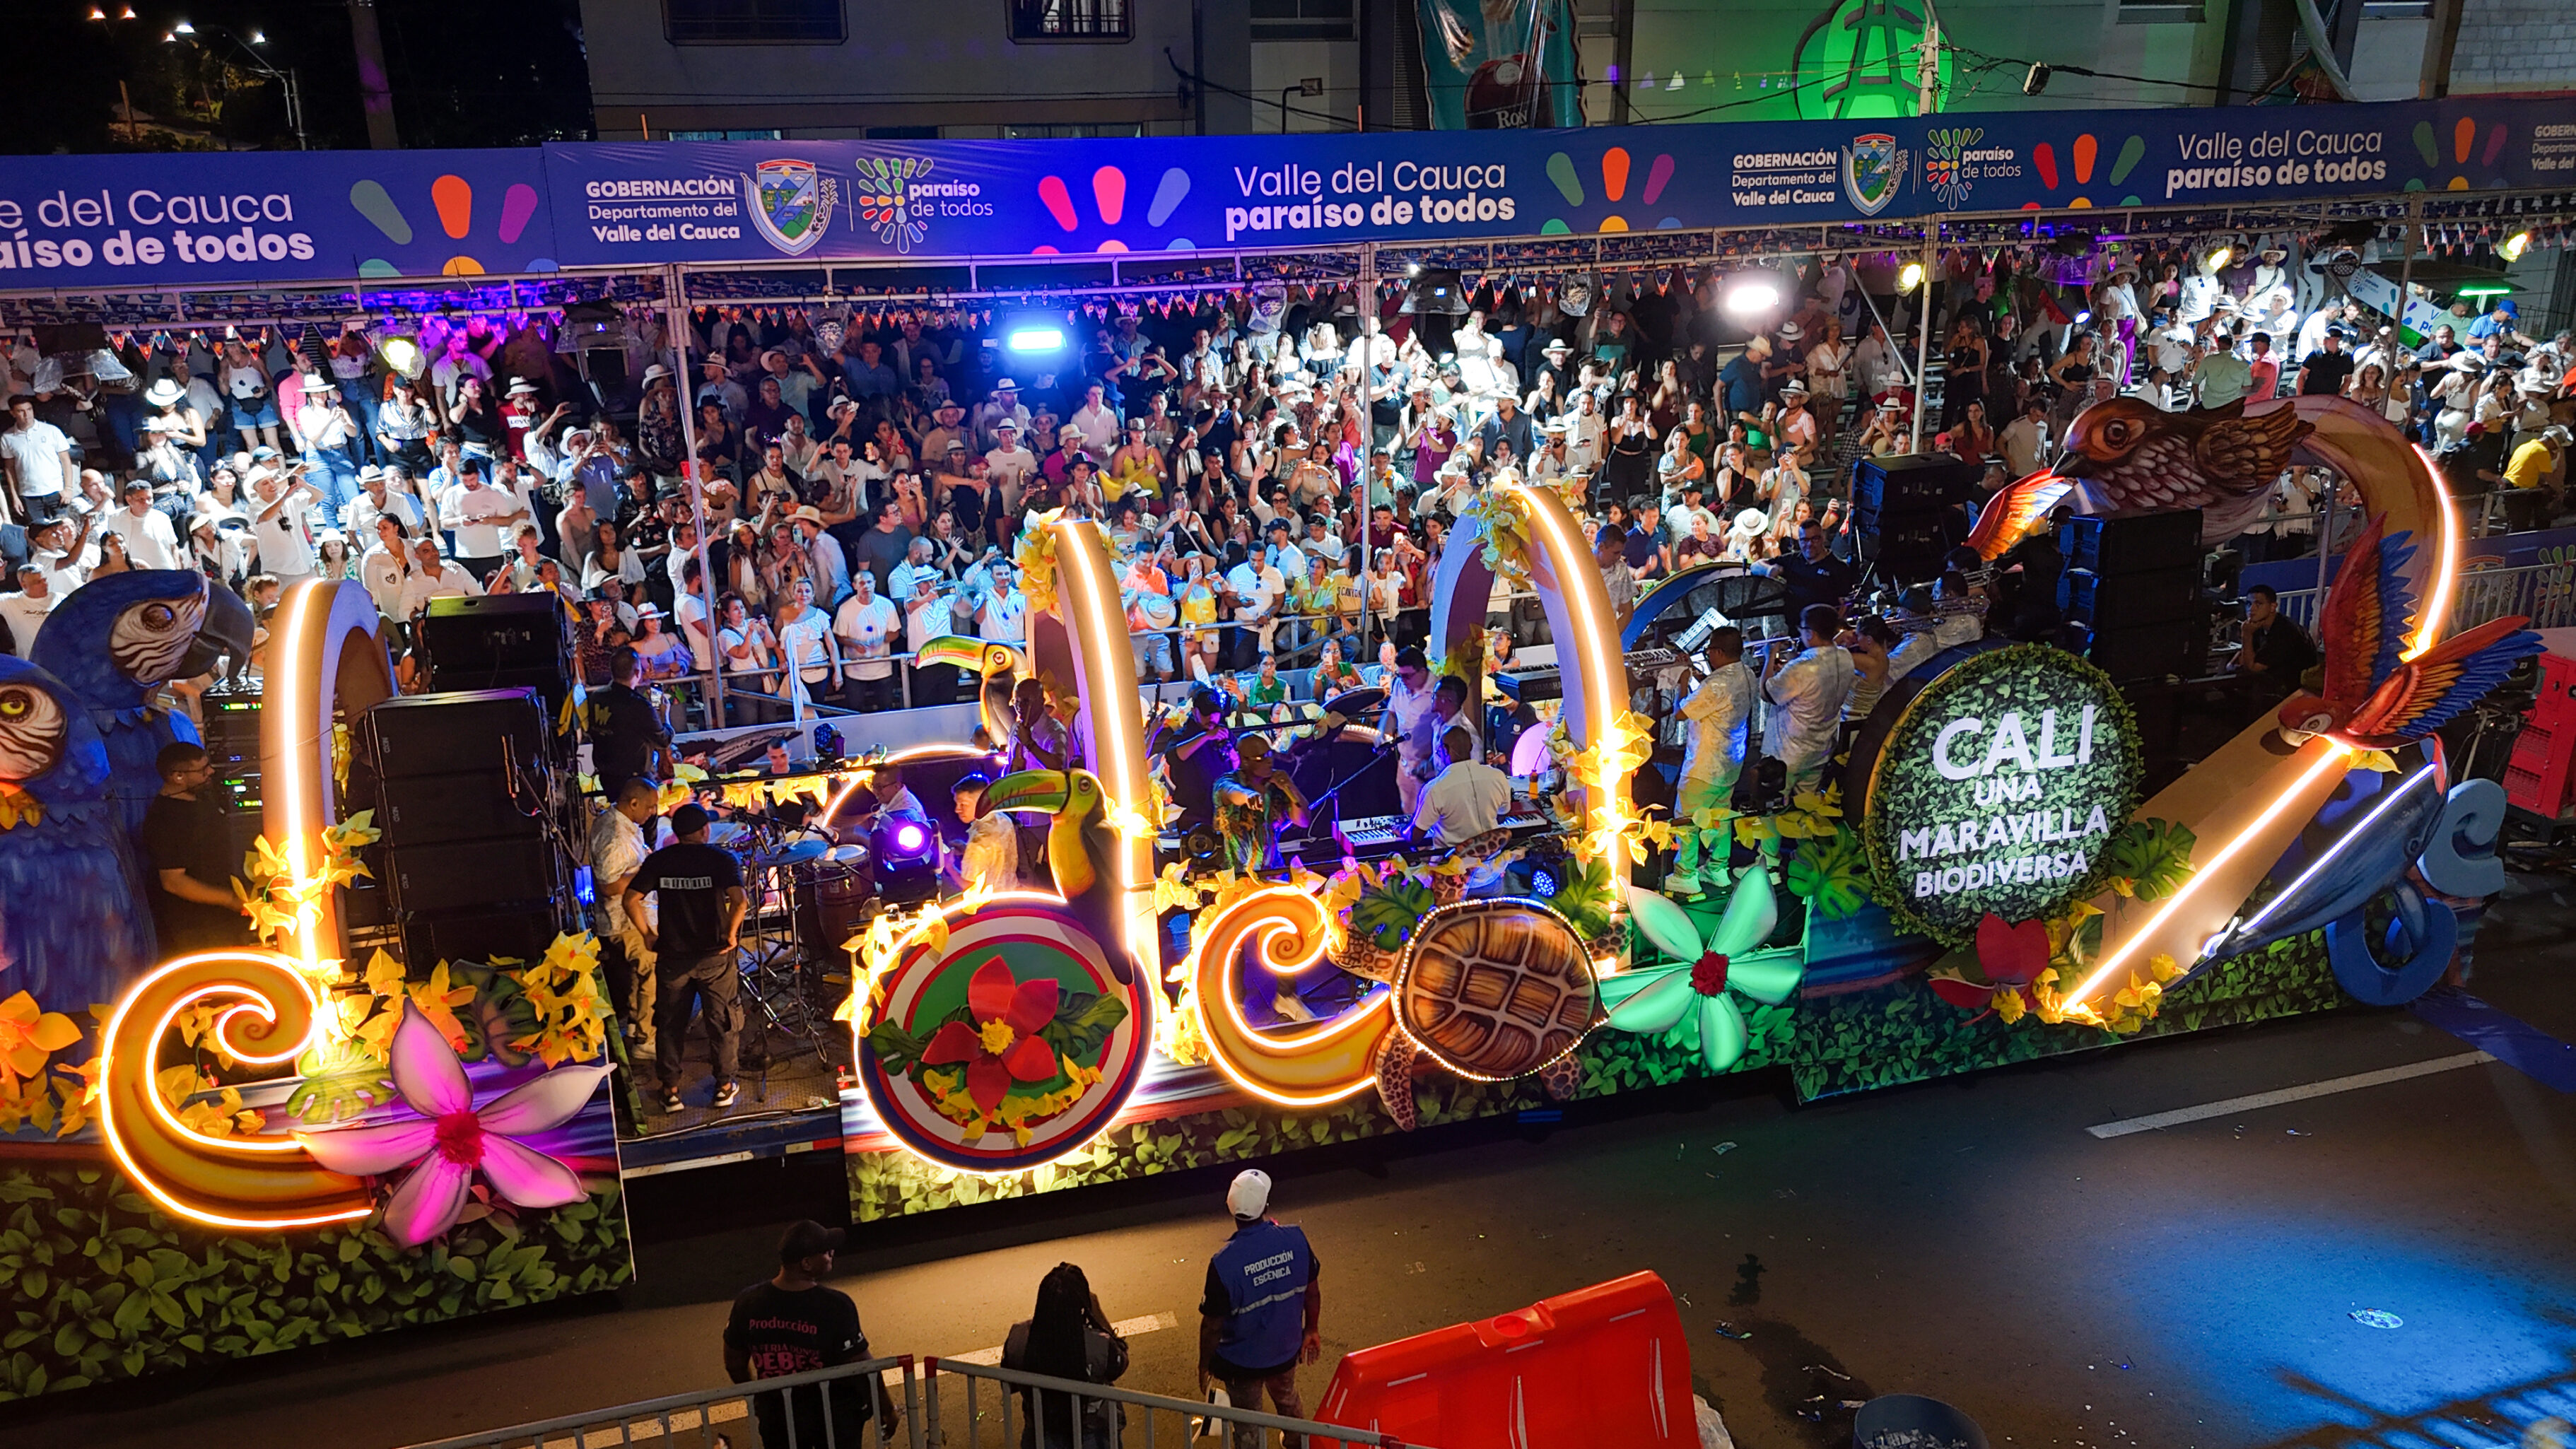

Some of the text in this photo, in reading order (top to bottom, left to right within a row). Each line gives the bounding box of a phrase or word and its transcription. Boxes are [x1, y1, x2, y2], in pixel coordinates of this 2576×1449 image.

[1962, 146, 2014, 165] paraíso
[2178, 129, 2382, 160] Valle del Cauca
[1733, 148, 1837, 169] GOBERNACIÓN
[1962, 161, 2022, 179] de todos
[2531, 156, 2575, 170] Valle del
[585, 174, 736, 198] GOBERNACIÓN
[1234, 160, 1505, 197] Valle del Cauca
[1732, 170, 1836, 189] Departamento del
[2165, 156, 2387, 199] paraíso de todos
[908, 179, 980, 202] paraíso
[1732, 189, 1835, 206] Valle del Cauca
[37, 189, 115, 228] del
[128, 189, 293, 225] Cauca
[588, 201, 738, 223] Departamento del
[911, 198, 993, 217] de todos
[1225, 192, 1516, 242] paraíso de todos
[591, 223, 741, 243] Valle del Cauca
[103, 229, 165, 266] de
[172, 226, 315, 263] todos
[1933, 705, 2095, 780] CALI
[1974, 774, 2043, 806] UNA
[1899, 804, 2109, 861] MARAVILLA
[1915, 850, 2089, 898] BIODIVERSA
[1243, 1250, 1294, 1276] PRODUCCIÓN
[1253, 1265, 1292, 1287] ESCÉNICA
[749, 1316, 817, 1334] Producción
